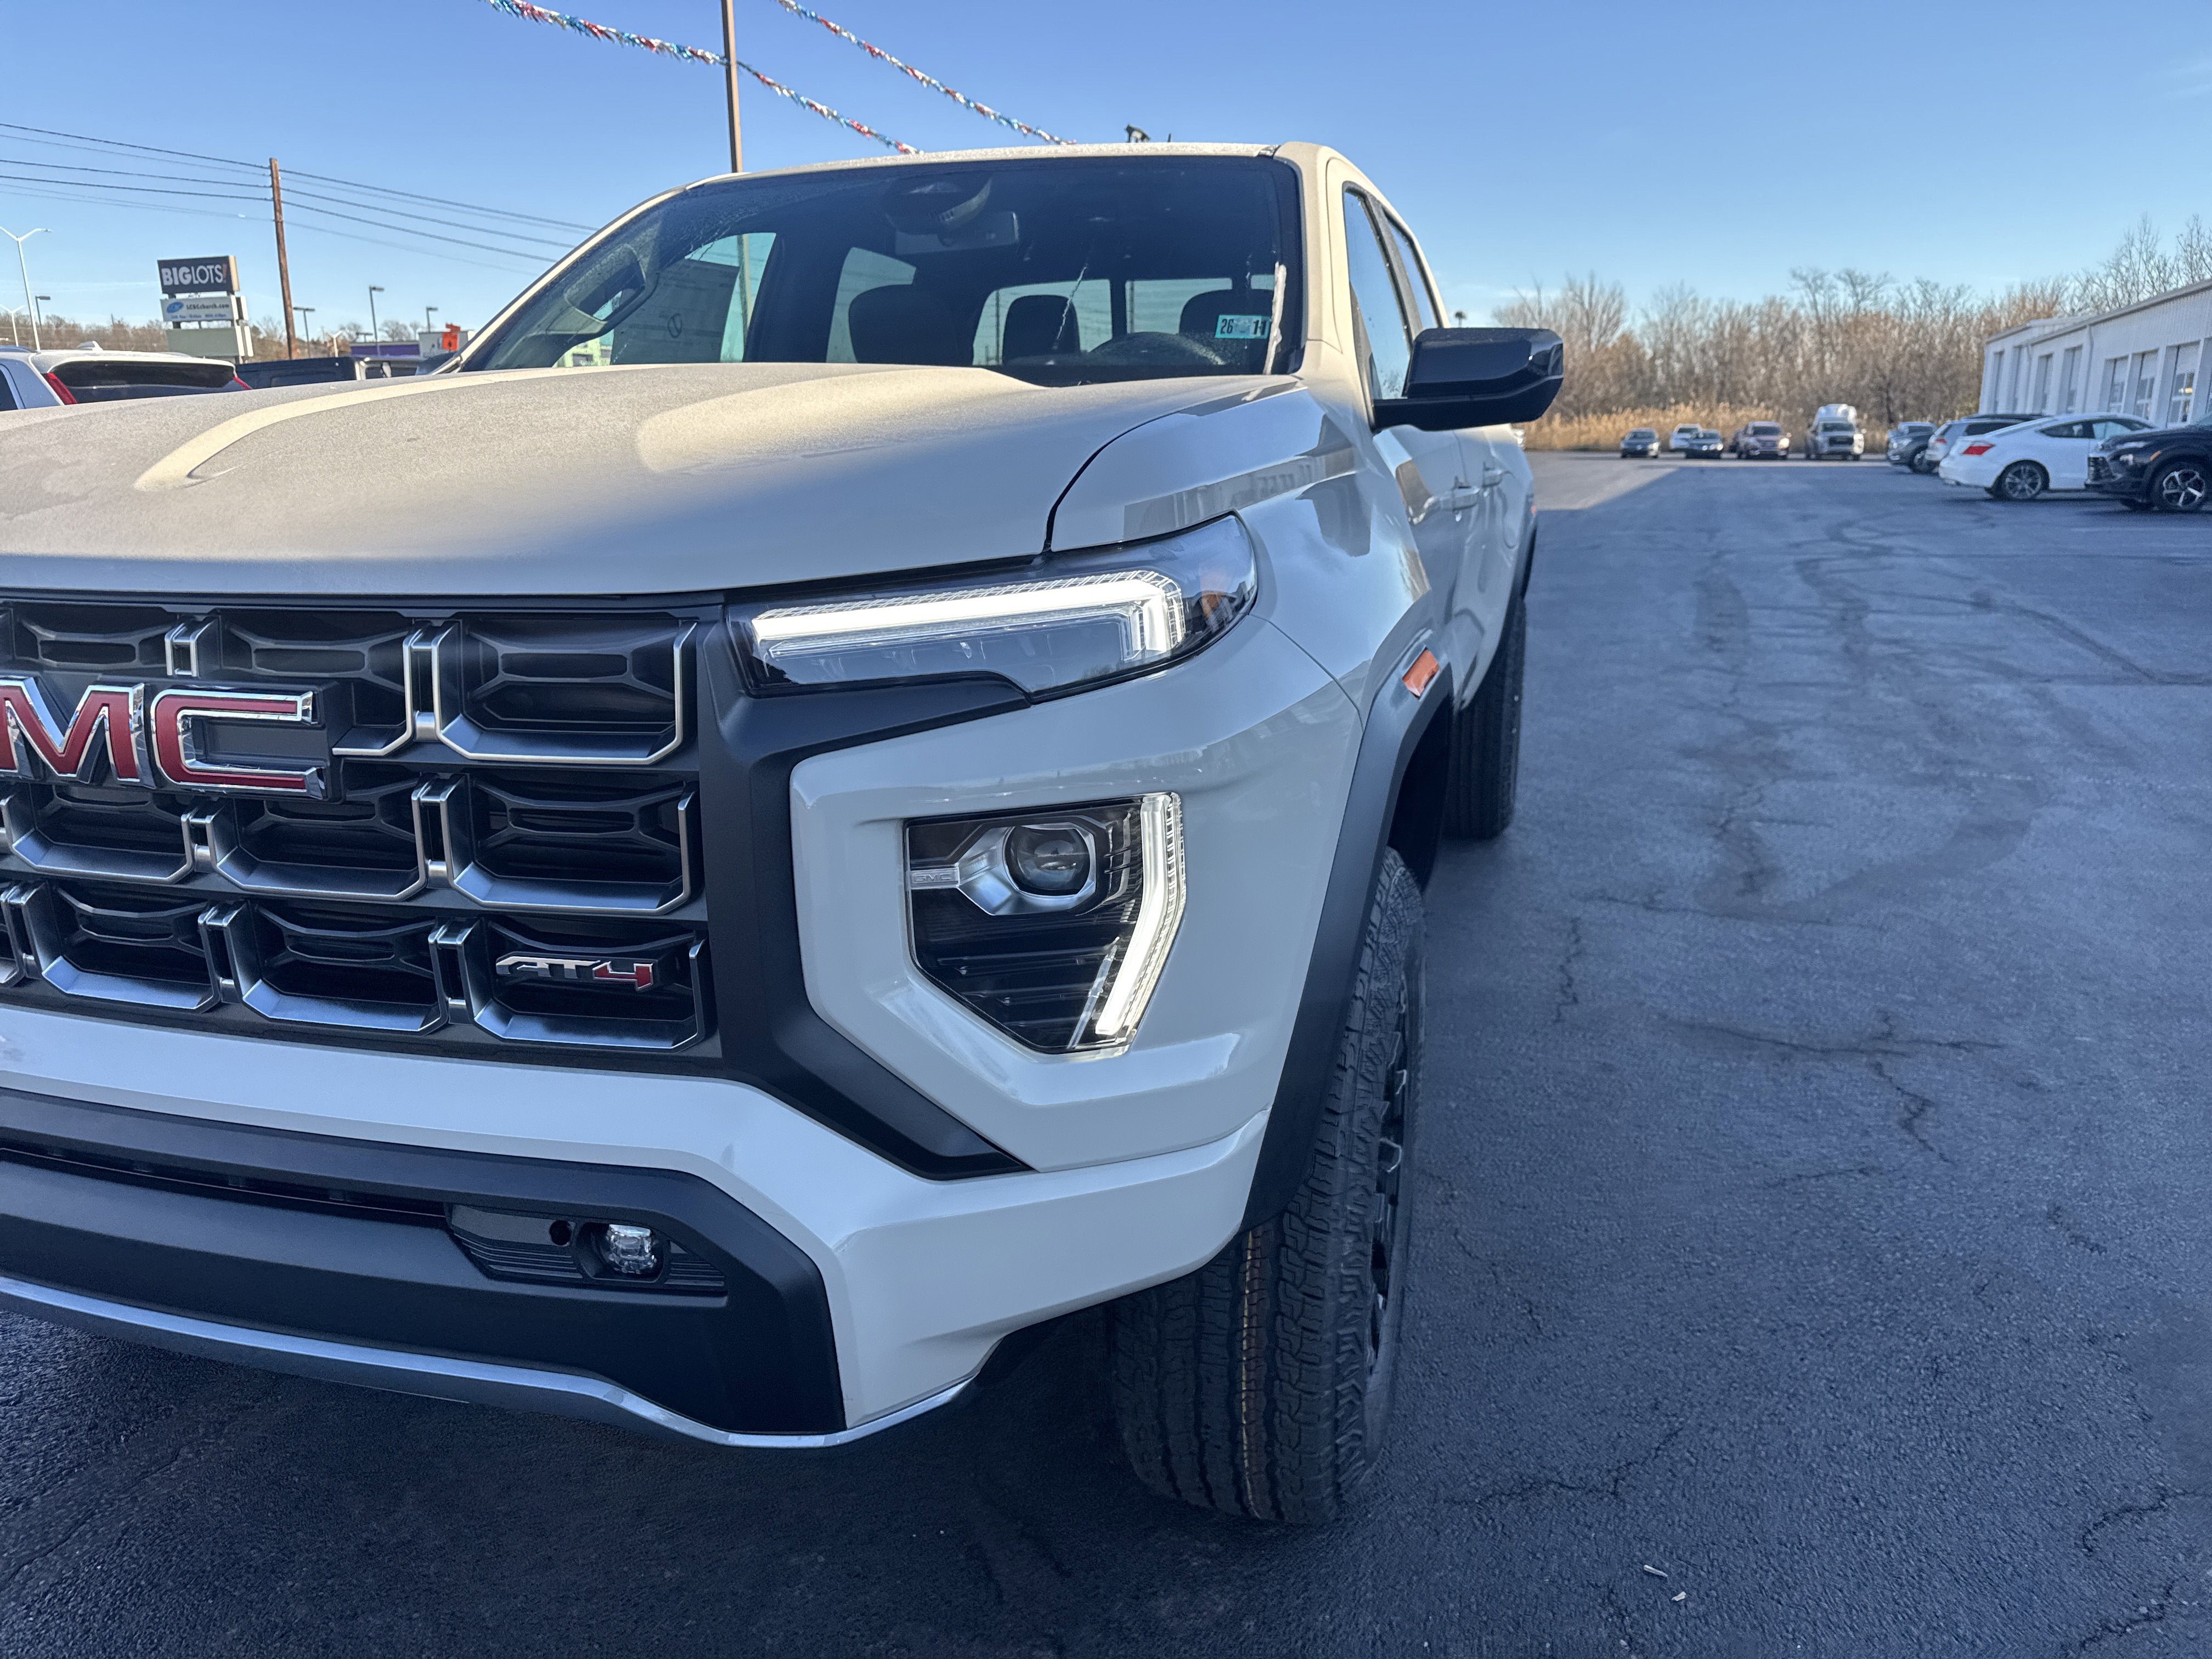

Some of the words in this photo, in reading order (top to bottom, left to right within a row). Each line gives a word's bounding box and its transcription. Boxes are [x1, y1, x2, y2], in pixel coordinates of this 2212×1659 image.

[1220, 319, 1233, 334] 26
[1253, 320, 1267, 335] 11
[912, 873, 952, 883] GMC
[496, 956, 653, 990] AT4
